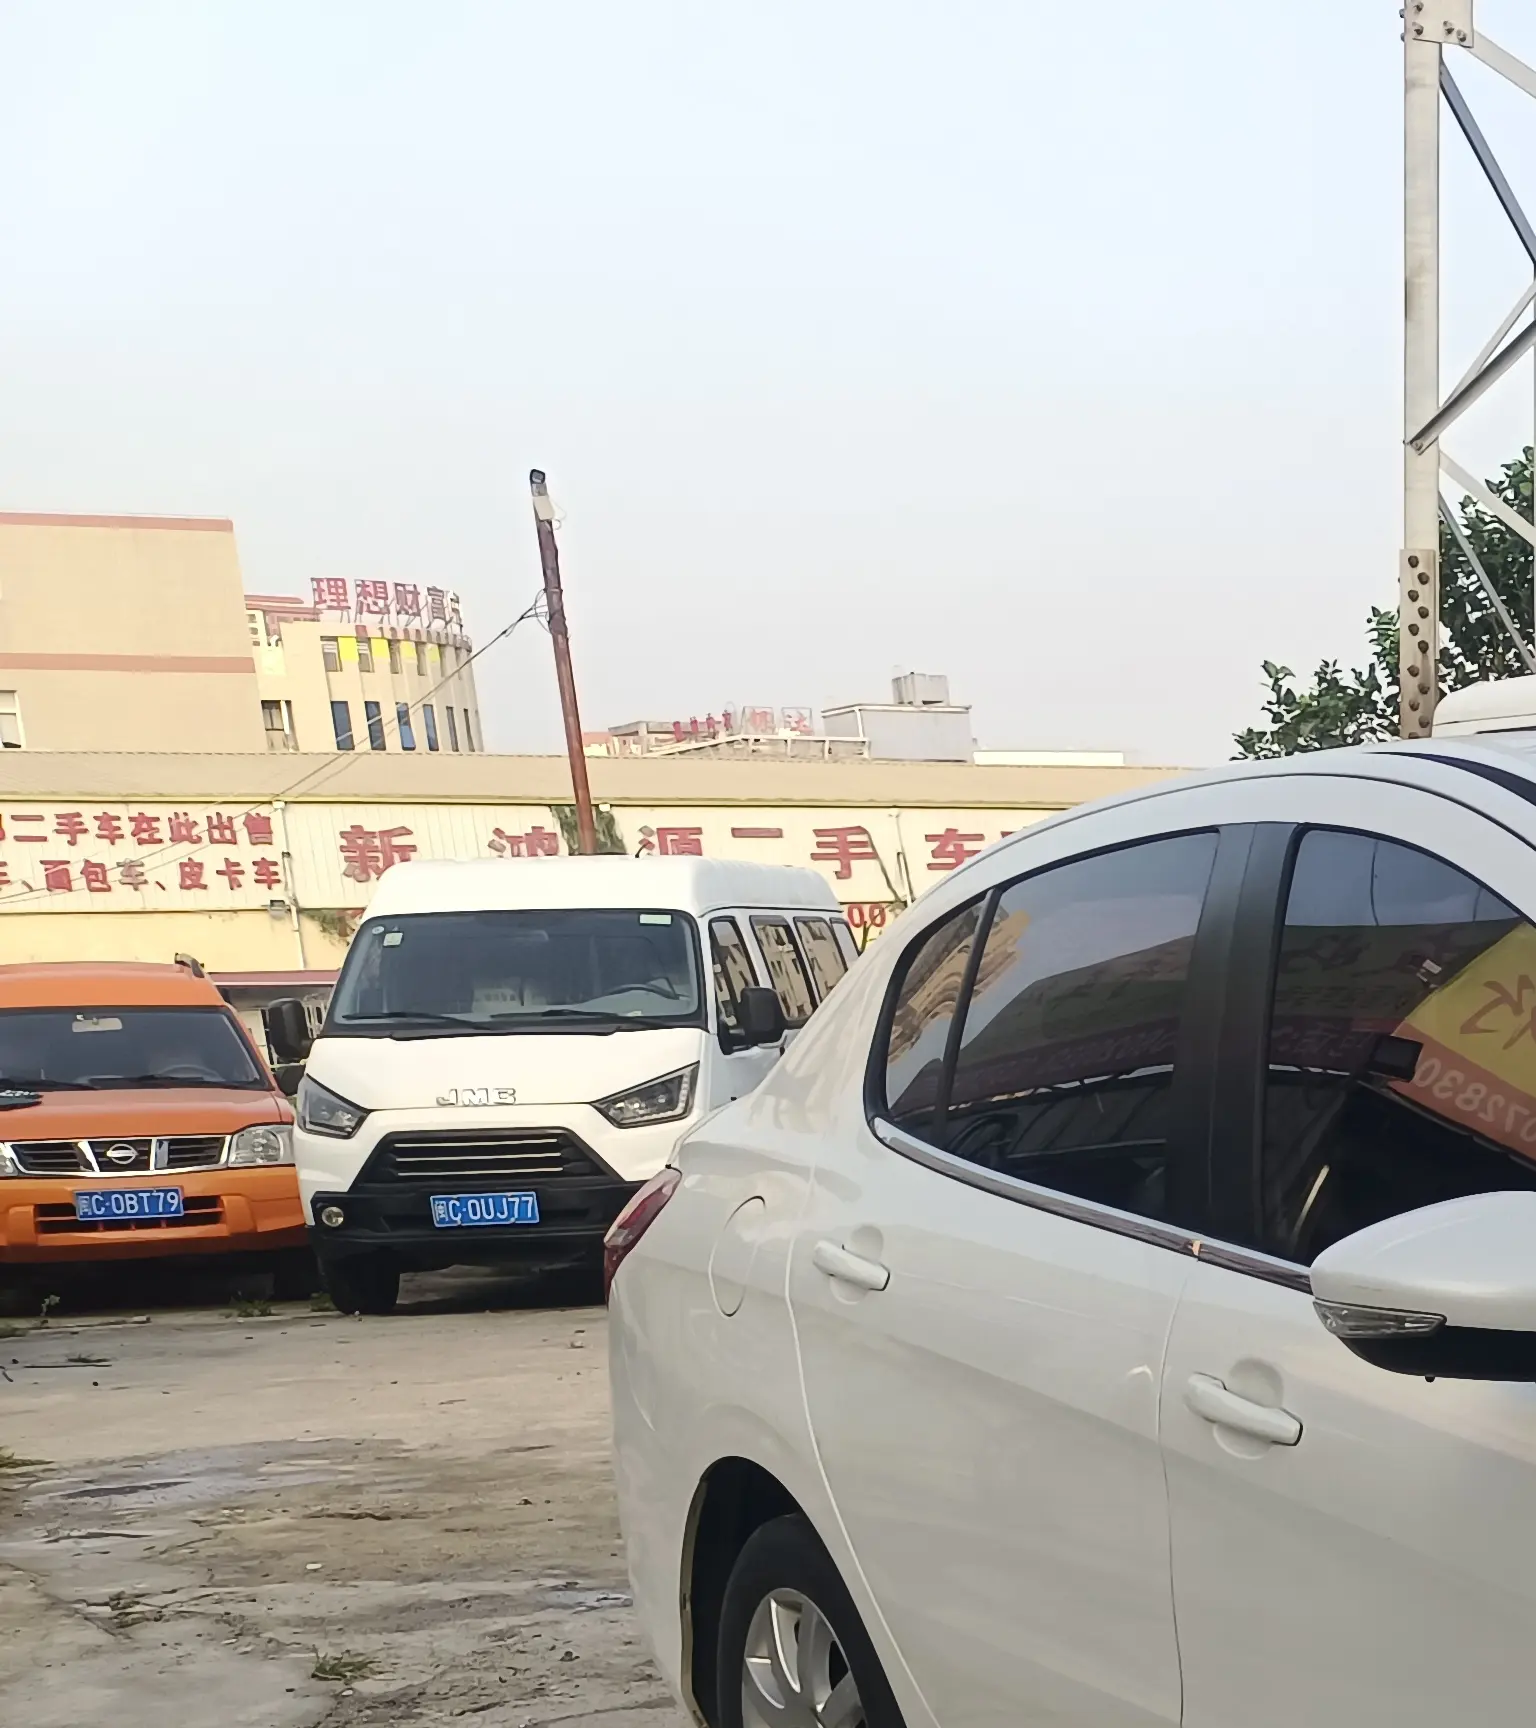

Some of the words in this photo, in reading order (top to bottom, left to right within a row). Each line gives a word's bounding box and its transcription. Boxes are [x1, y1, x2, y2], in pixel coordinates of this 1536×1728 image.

[0, 811, 273, 846] 二手车在此出售
